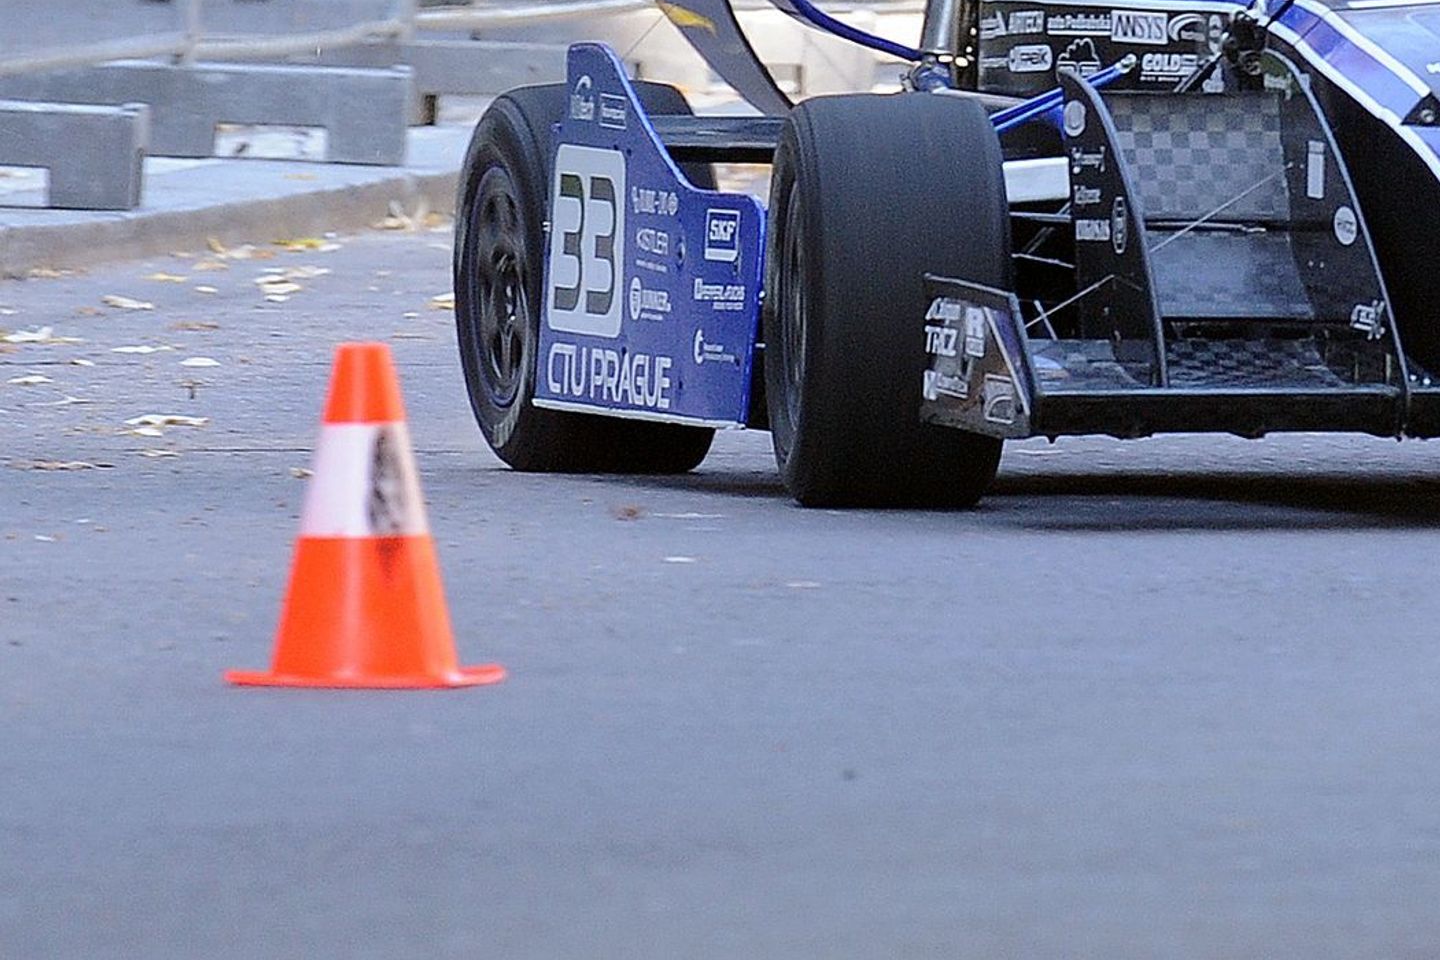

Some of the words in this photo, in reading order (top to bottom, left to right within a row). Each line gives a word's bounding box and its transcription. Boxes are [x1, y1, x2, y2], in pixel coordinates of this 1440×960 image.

[554, 173, 617, 317] 33
[548, 342, 587, 397] CTU
[589, 347, 672, 409] PRAGUE
